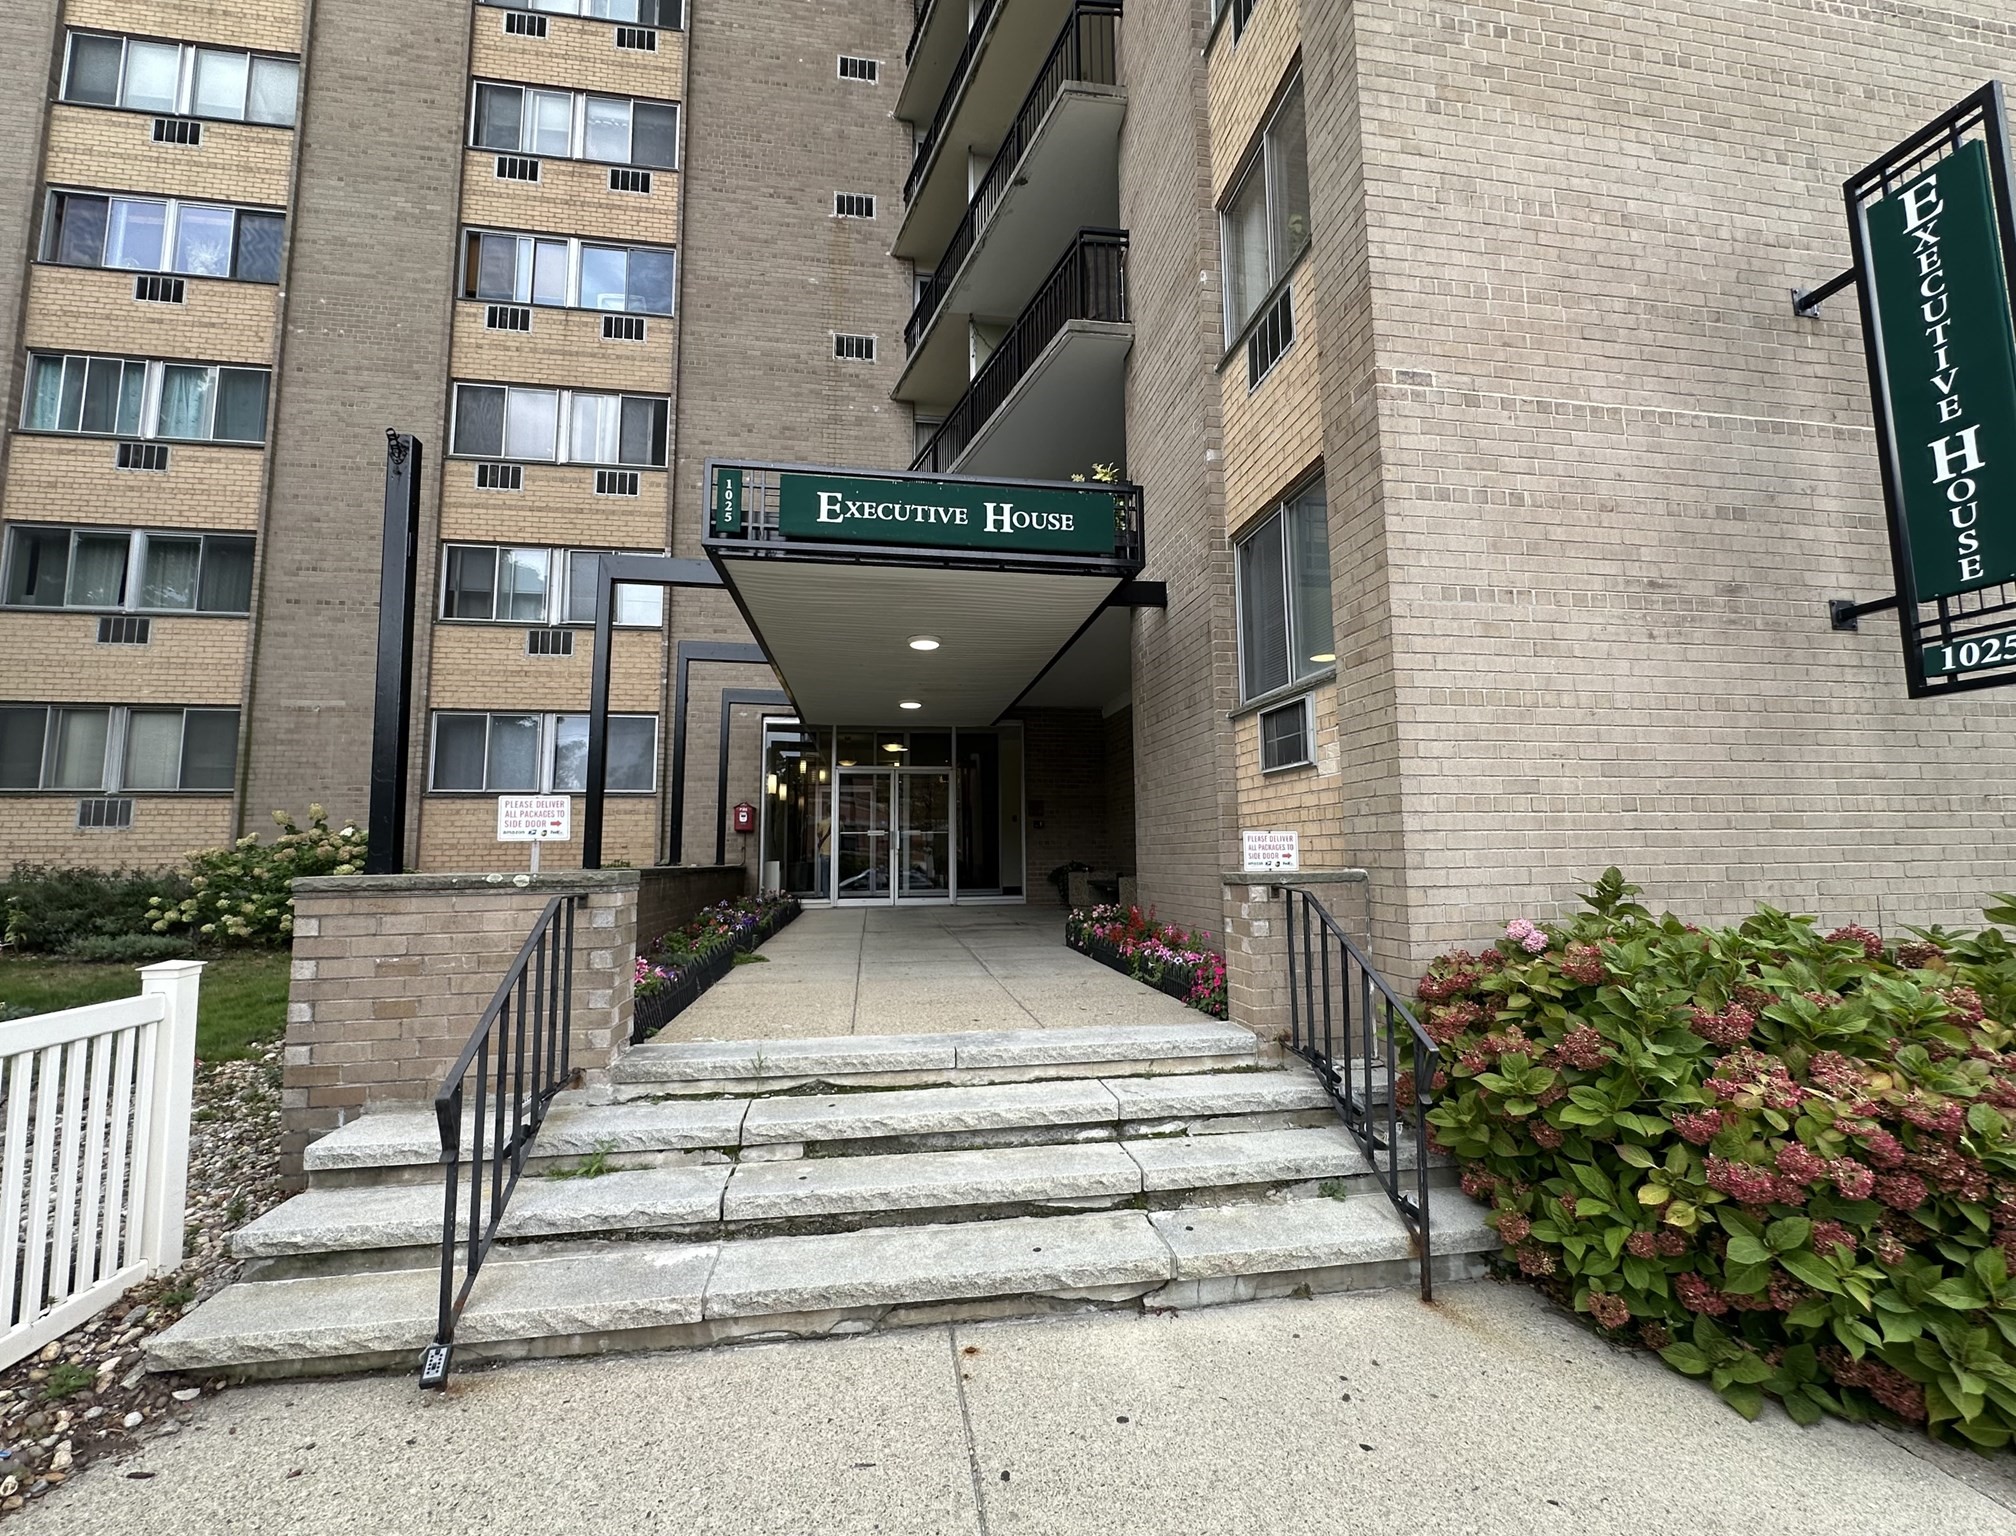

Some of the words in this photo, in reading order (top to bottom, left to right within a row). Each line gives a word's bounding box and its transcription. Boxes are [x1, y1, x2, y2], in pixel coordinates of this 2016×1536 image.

[1897, 173, 1964, 425] EXECUTIVE
[724, 479, 733, 522] 1025
[816, 491, 969, 525] EXECUTIVE
[983, 502, 1075, 533] HOUSE
[1927, 424, 1987, 583] HOUSE
[1941, 634, 2016, 670] 1025
[505, 800, 533, 808] PLEASE
[536, 800, 565, 808] DELIVER
[505, 810, 517, 818] ALL
[520, 810, 555, 818] PACKAGES
[557, 810, 565, 818] TO
[504, 820, 522, 828] SIDE
[525, 820, 547, 828] DOOR
[1248, 852, 1261, 860] SIDE
[1262, 852, 1279, 860] DOOR
